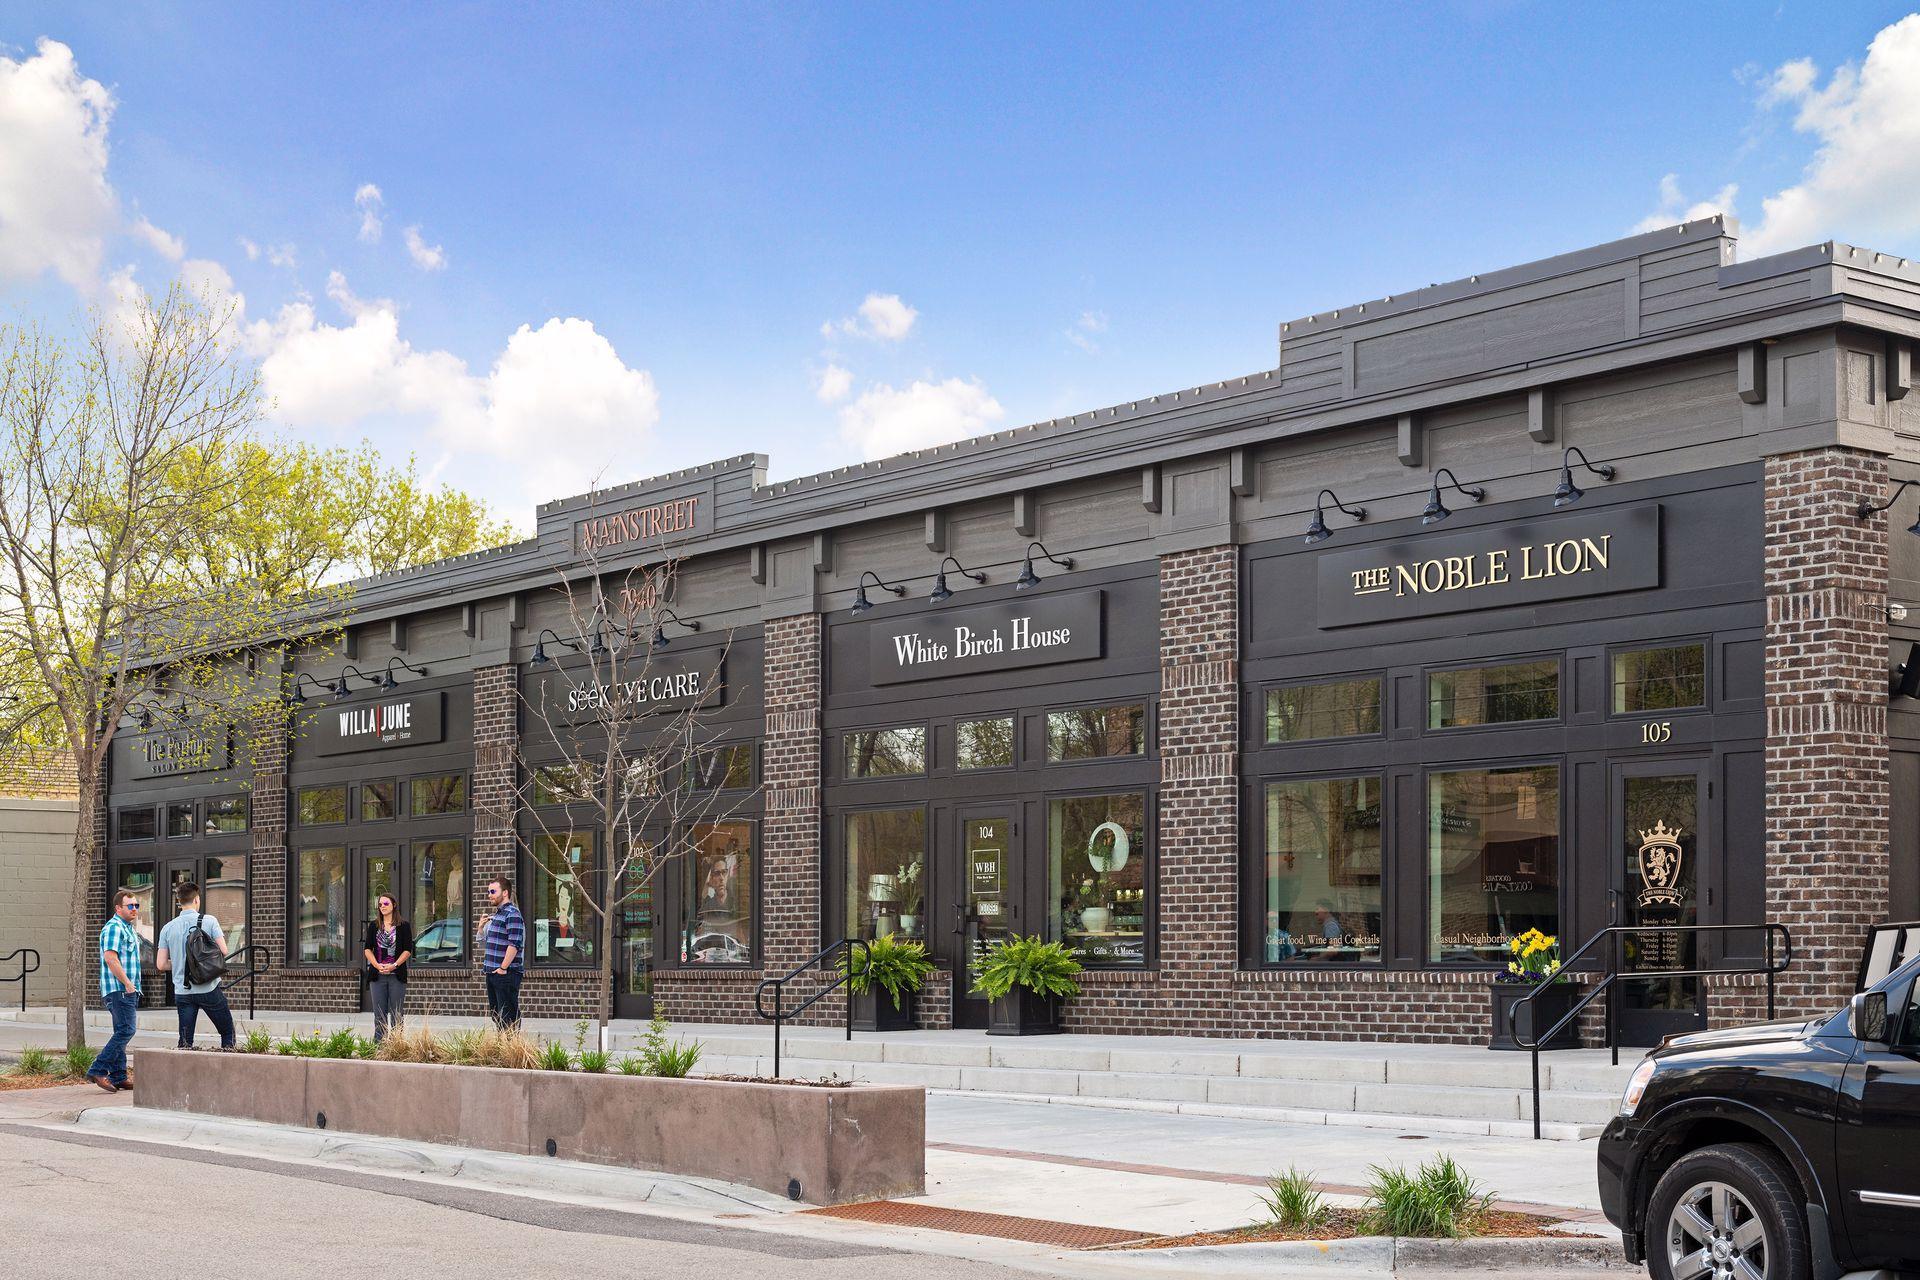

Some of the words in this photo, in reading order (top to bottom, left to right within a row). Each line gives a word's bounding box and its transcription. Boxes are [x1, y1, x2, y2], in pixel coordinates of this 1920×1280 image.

[583, 498, 699, 549] MAINSTREET
[1351, 566, 1391, 589] THE
[1395, 550, 1510, 597] NOBLE
[1520, 535, 1612, 581] LION
[892, 633, 948, 667] White
[954, 626, 1004, 659] Birch
[1010, 616, 1071, 652] House
[650, 671, 700, 701] CARE
[339, 708, 376, 737] WILLA
[380, 702, 411, 732] JUNE
[399, 731, 411, 740] Home
[1641, 722, 1671, 743] 105
[144, 738, 162, 762] The
[979, 826, 994, 839] 104
[633, 847, 644, 858] 103
[974, 861, 996, 874] WBH
[1287, 934, 1306, 946] food,
[1308, 934, 1328, 945] Wine
[1329, 934, 1343, 945] and
[1344, 933, 1381, 946] Cocktails
[1433, 932, 1461, 945] Casual
[1093, 946, 1108, 956] Gifts
[1120, 945, 1135, 955] More
